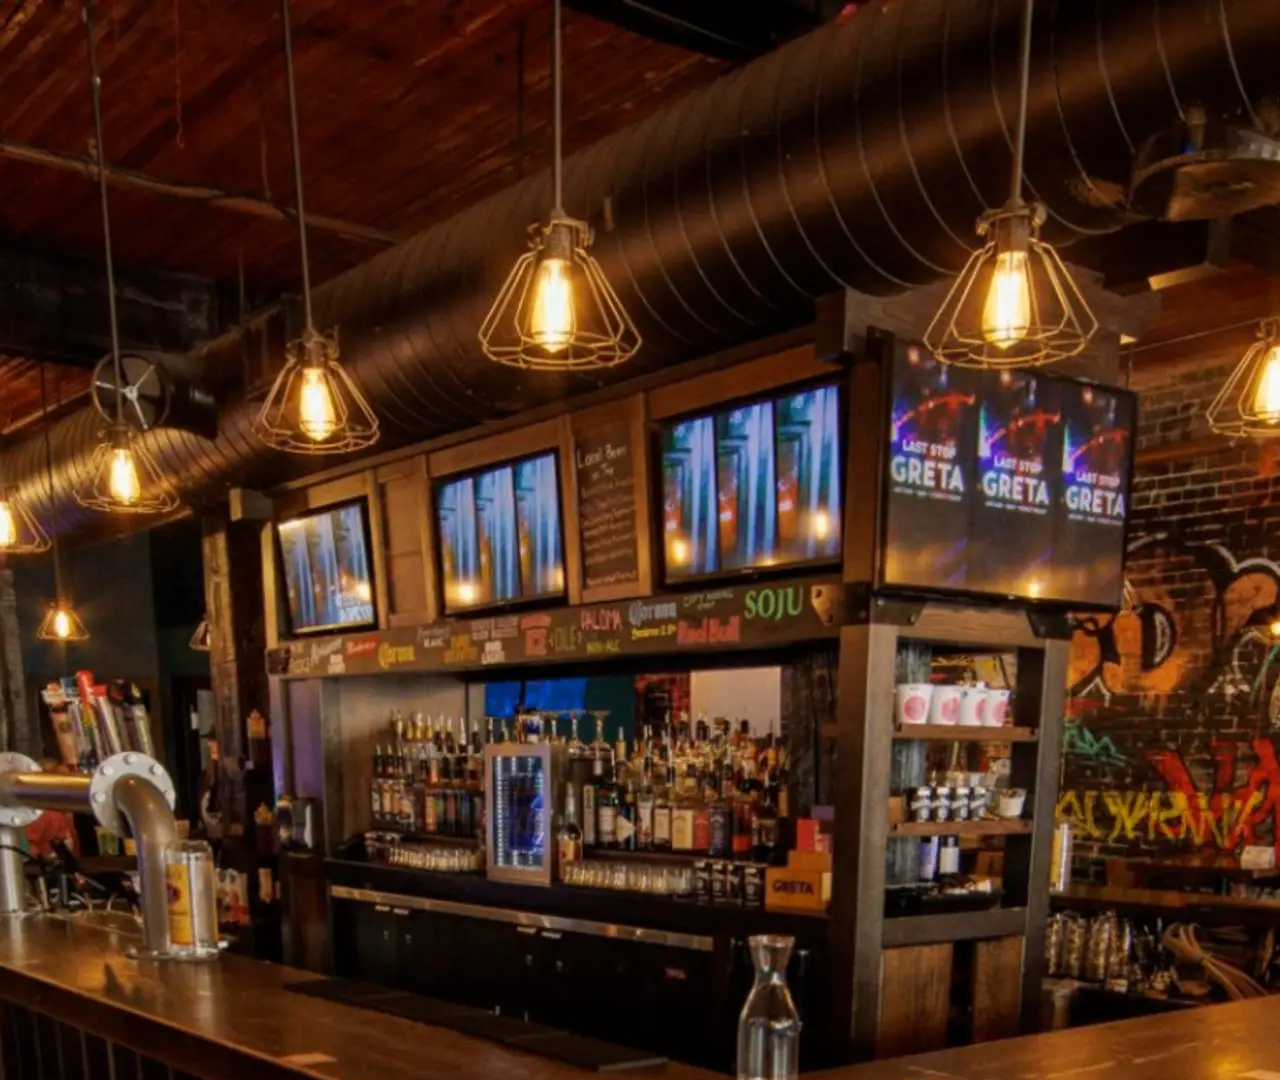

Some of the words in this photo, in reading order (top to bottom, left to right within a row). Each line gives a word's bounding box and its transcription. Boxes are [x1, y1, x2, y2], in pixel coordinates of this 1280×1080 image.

[902, 439, 927, 454] LAST
[929, 442, 957, 459] STOP
[890, 454, 965, 493] GRETA
[994, 455, 1017, 471] LAST
[982, 471, 1050, 505] GRETA
[1075, 471, 1098, 485] LAST
[1065, 485, 1126, 518] GRETA
[628, 600, 678, 626] Corona
[744, 585, 805, 621] SOJU
[580, 608, 623, 632] PALOMA
[772, 880, 816, 897] GRETA
